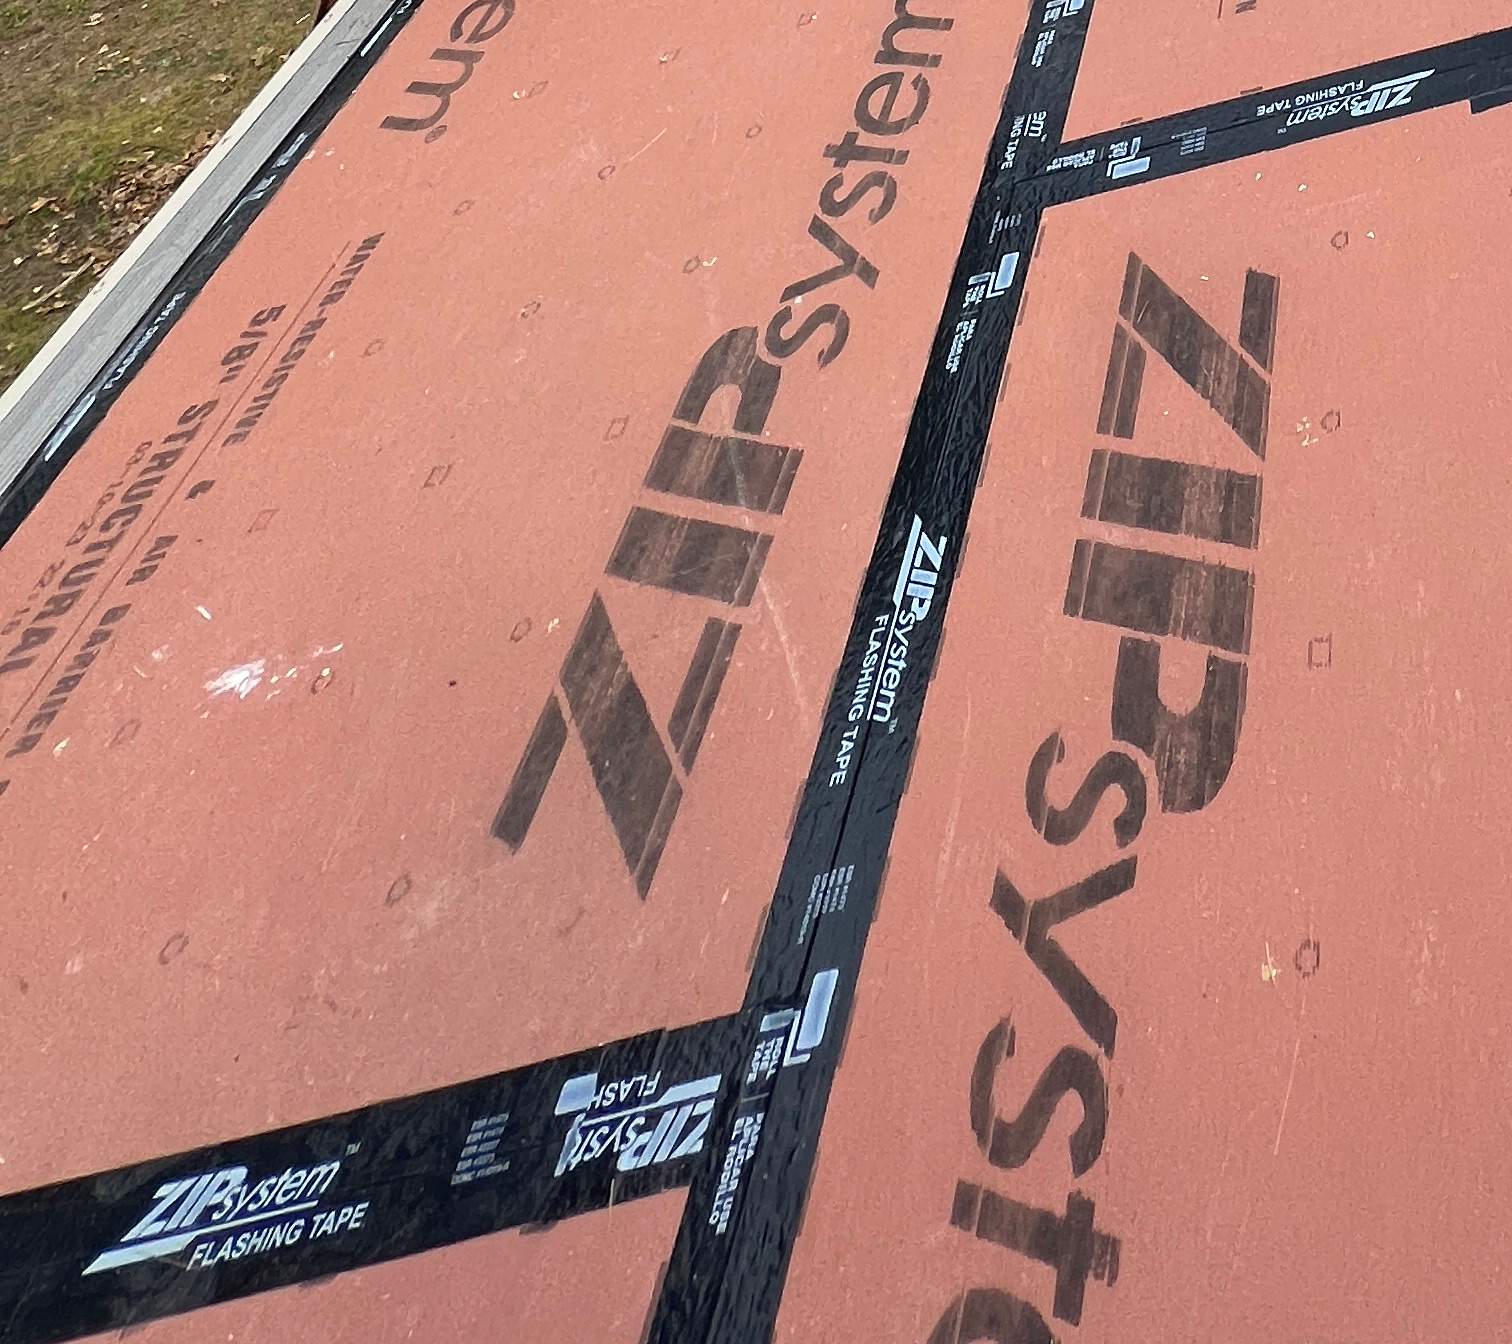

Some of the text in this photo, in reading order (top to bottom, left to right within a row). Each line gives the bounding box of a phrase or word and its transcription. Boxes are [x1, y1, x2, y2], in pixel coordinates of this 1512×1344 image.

[1256, 79, 1364, 116] FLASHING TAPE
[222, 232, 385, 446] WATER-RESISTIVE
[127, 536, 177, 586] AIR
[5, 604, 131, 757] BARRIER
[828, 614, 889, 789] FLASHING TAPE
[186, 1202, 370, 1272] FLASHING TAPE
